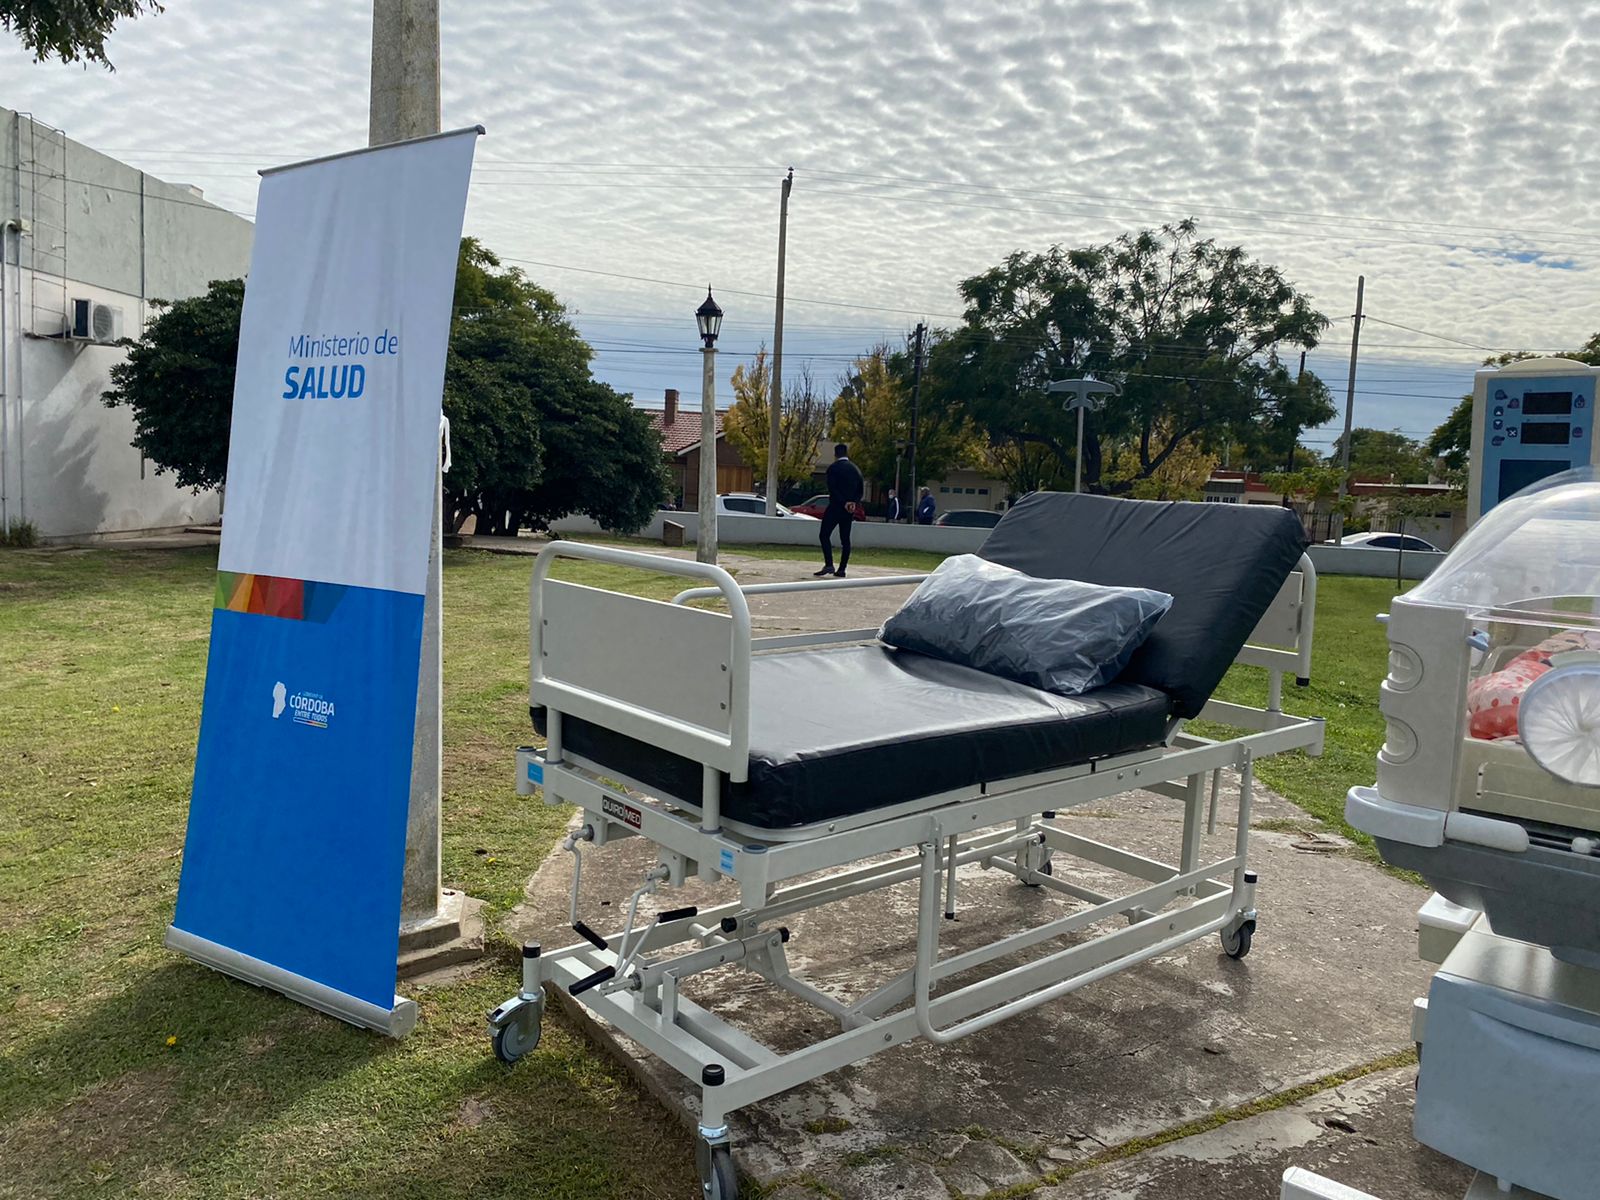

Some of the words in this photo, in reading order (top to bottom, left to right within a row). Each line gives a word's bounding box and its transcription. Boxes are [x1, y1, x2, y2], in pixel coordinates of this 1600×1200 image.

[288, 331, 370, 359] Ministerio
[374, 328, 399, 355] de
[282, 364, 366, 400] SALUD
[289, 691, 335, 717] CÓRDOBA
[294, 709, 310, 719] ENTRE
[311, 712, 328, 723] TODOS
